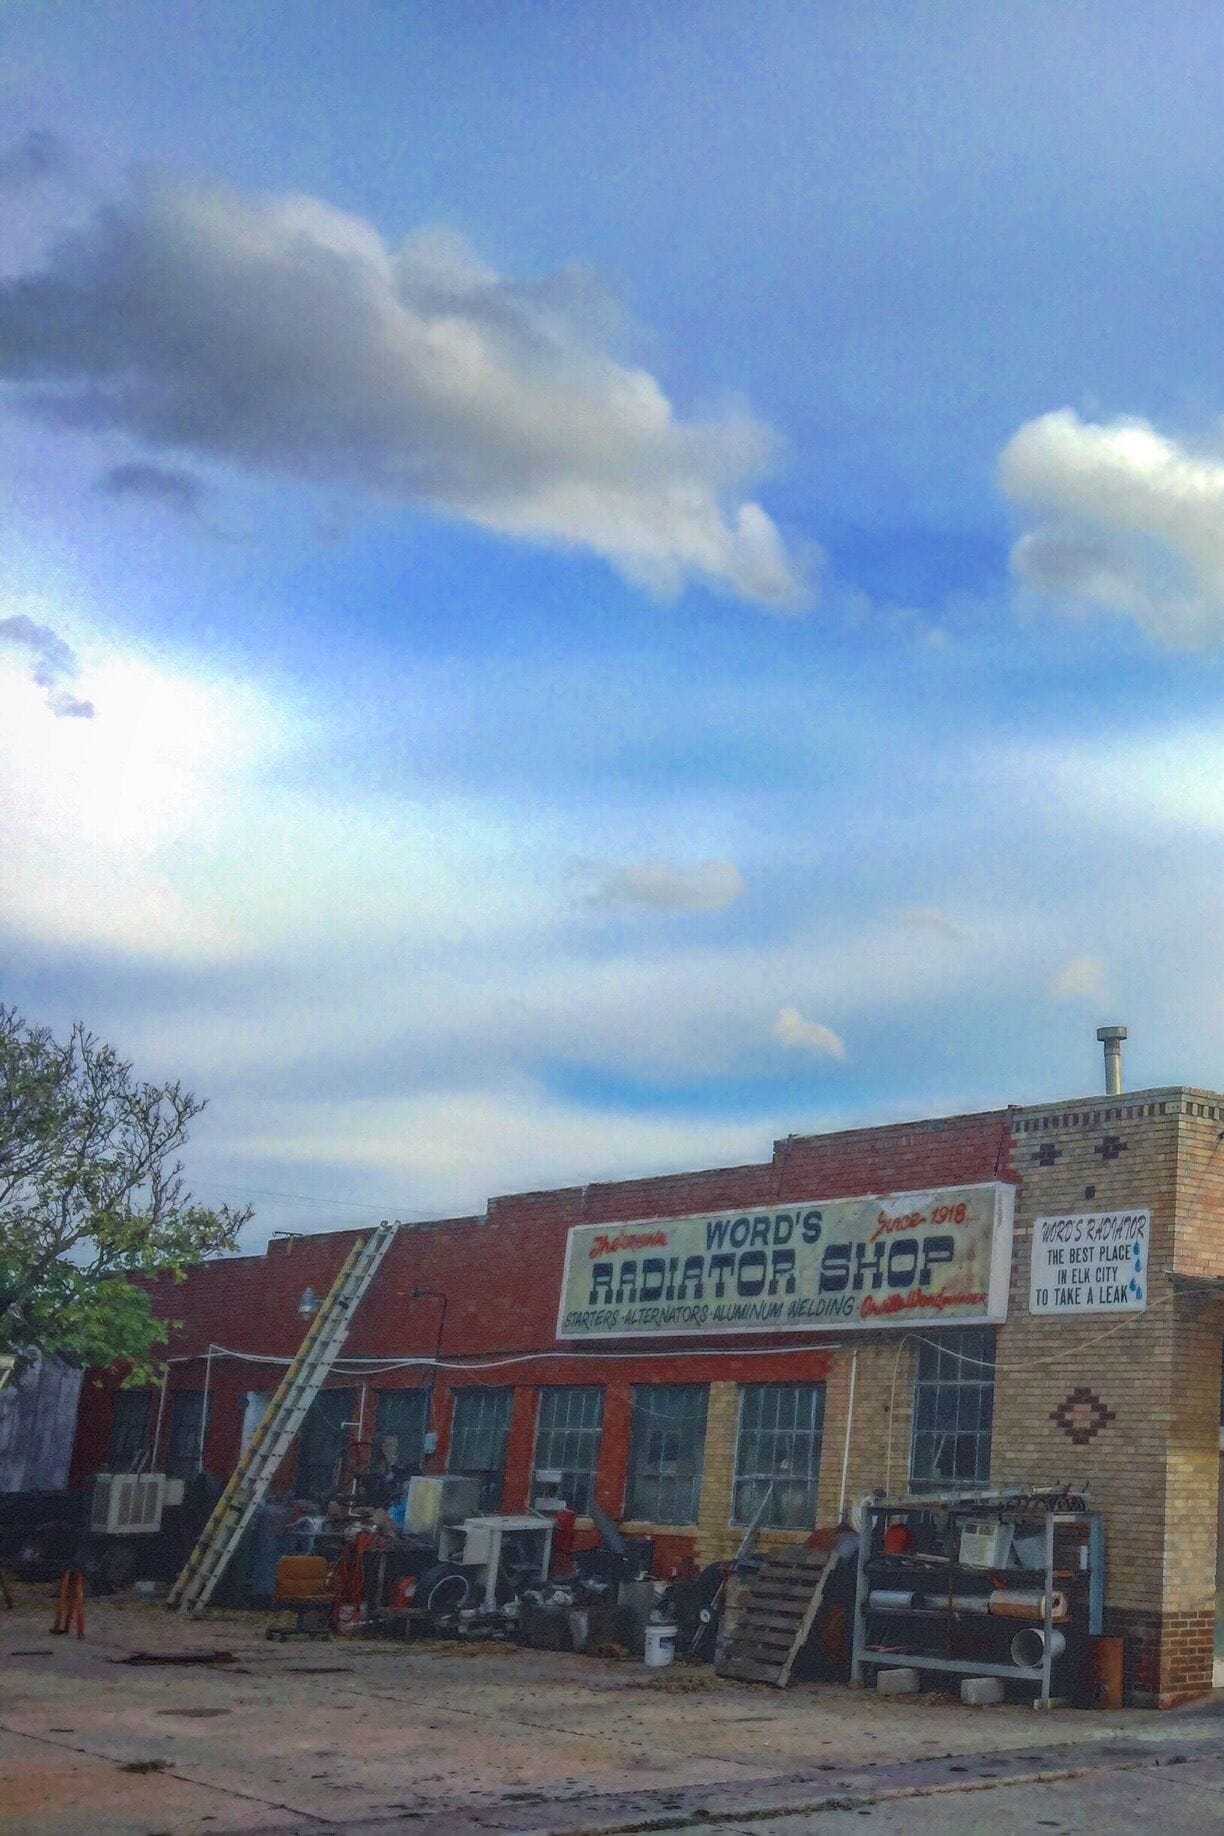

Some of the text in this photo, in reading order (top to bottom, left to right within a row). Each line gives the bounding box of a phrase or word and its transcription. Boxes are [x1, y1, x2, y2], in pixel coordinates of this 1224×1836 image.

[706, 1210, 823, 1250] WORD'S
[870, 1210, 927, 1243] Since
[1041, 1214, 1147, 1243] WORD'S RADIATOR
[588, 1234, 955, 1305] RADIATOR SHOP
[1047, 1244, 1132, 1266] THE BEST PLACE
[1057, 1266, 1119, 1285] IN ELK CITY
[1036, 1284, 1129, 1306] TO TAKE A LEAK
[564, 1309, 619, 1330] STARTERS
[623, 1304, 709, 1328] ALTERNATORS
[713, 1299, 784, 1322] ALUMINUM
[787, 1295, 856, 1317] WELDING
